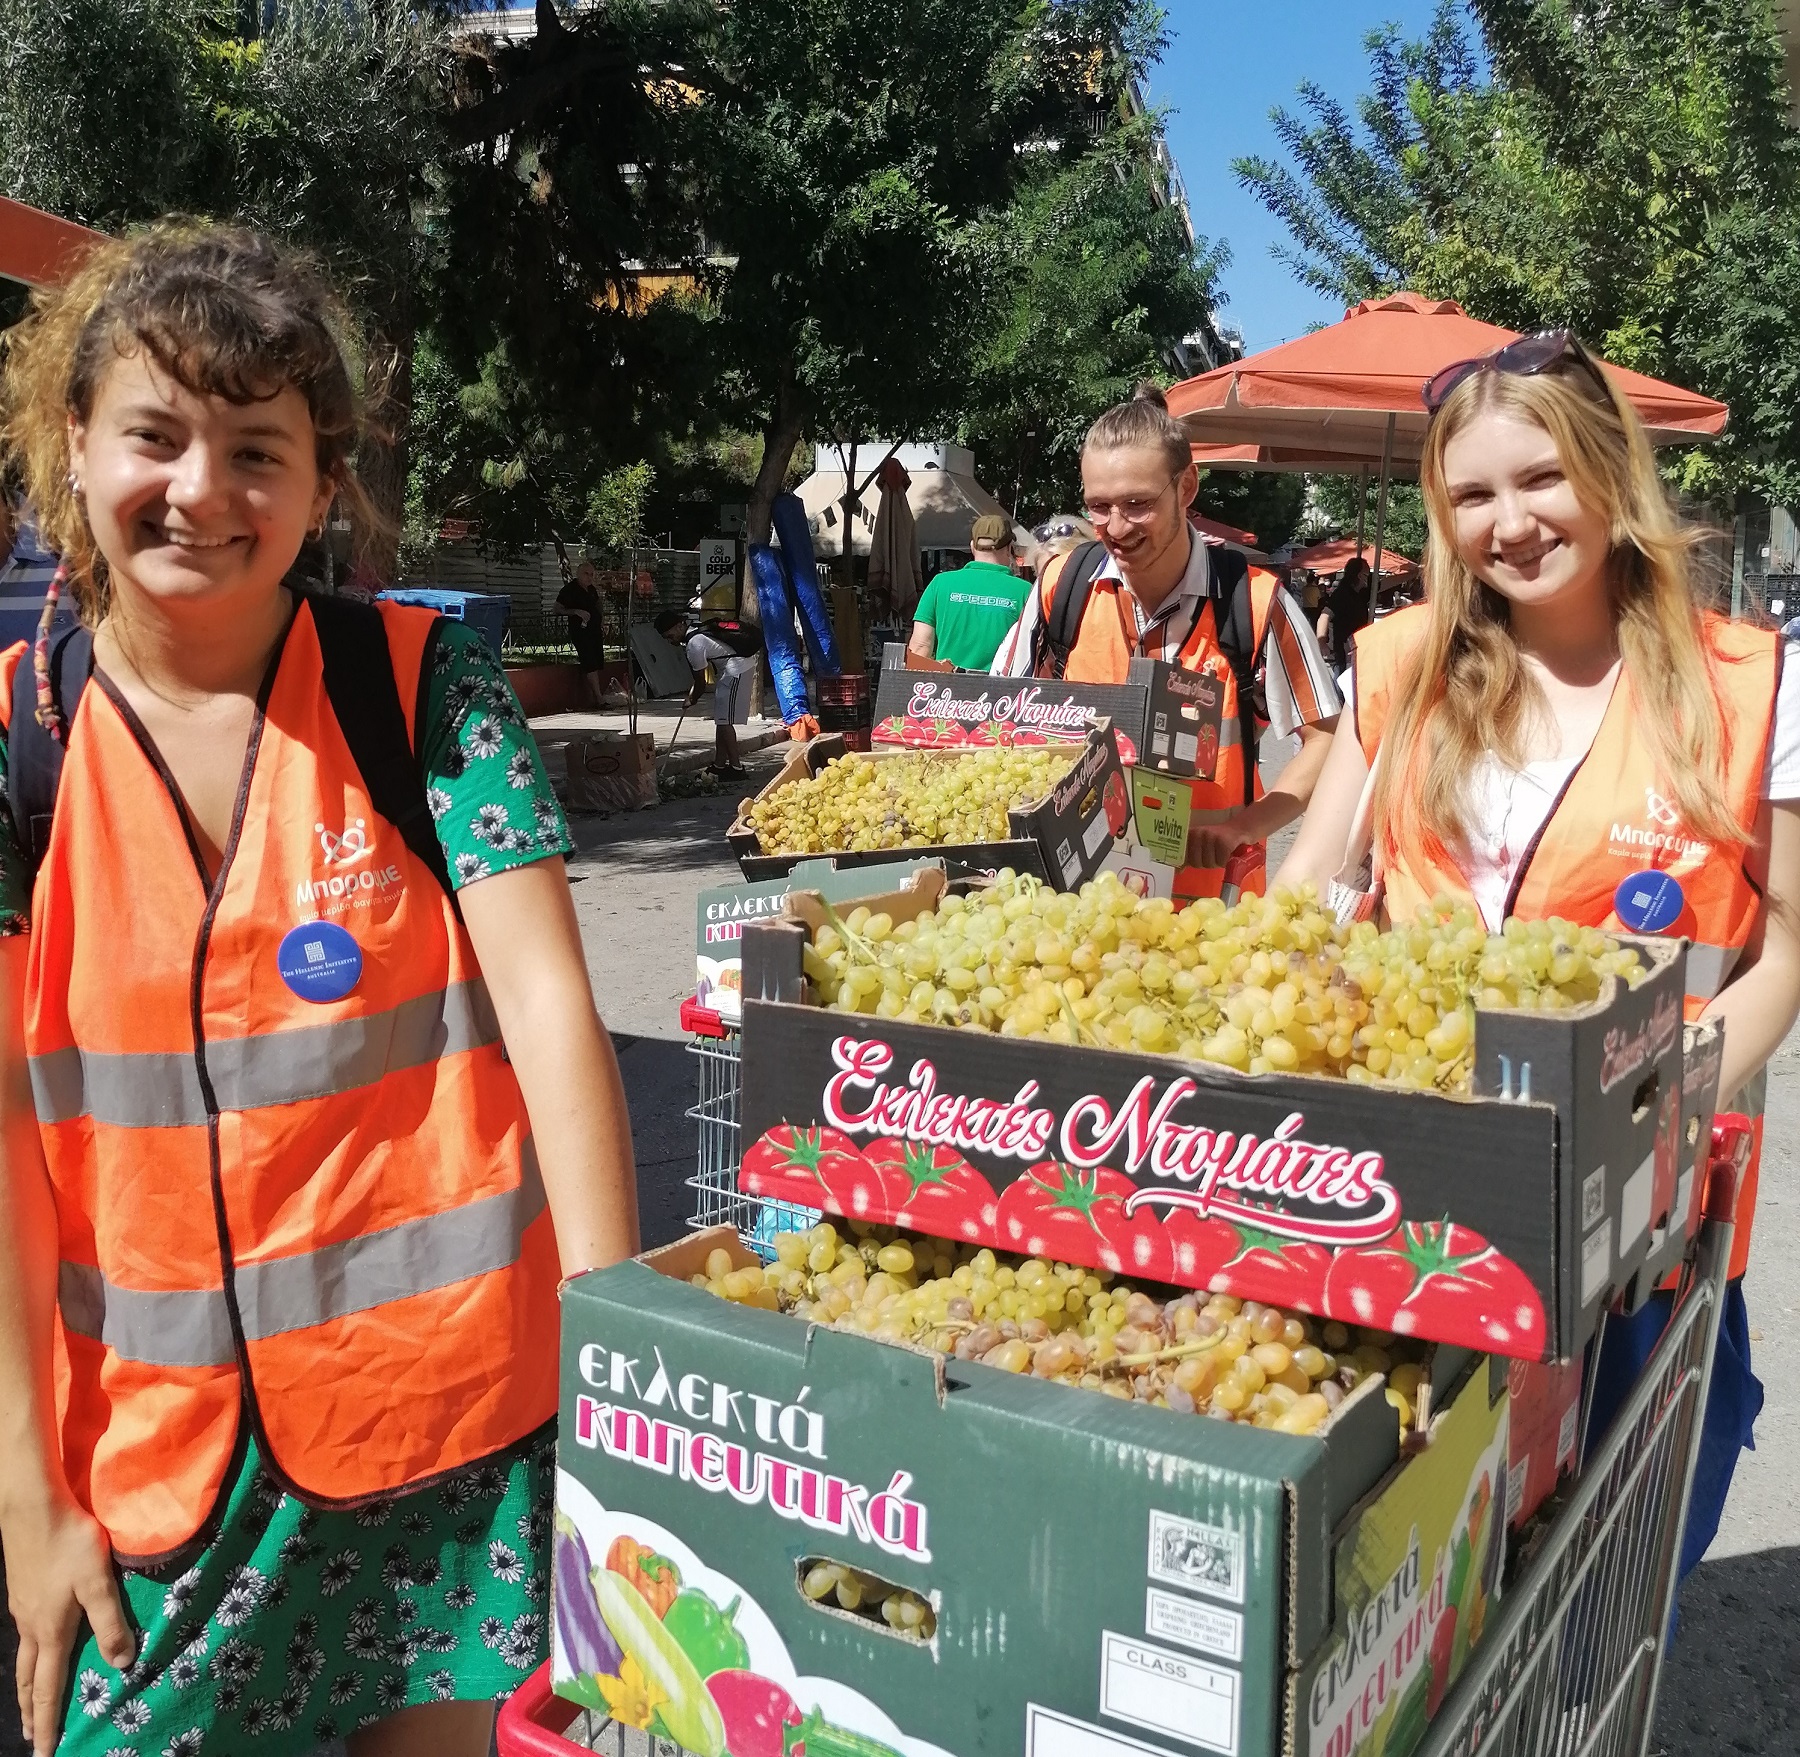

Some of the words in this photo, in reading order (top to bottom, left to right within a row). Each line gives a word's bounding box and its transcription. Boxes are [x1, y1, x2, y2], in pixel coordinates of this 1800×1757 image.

[706, 564, 734, 575] BEER
[1153, 815, 1183, 839] velvita
[822, 1036, 1055, 1158] Εκλεκτές
[1060, 1075, 1400, 1236] Ντομάτες
[1127, 1650, 1187, 1679] CLASS
